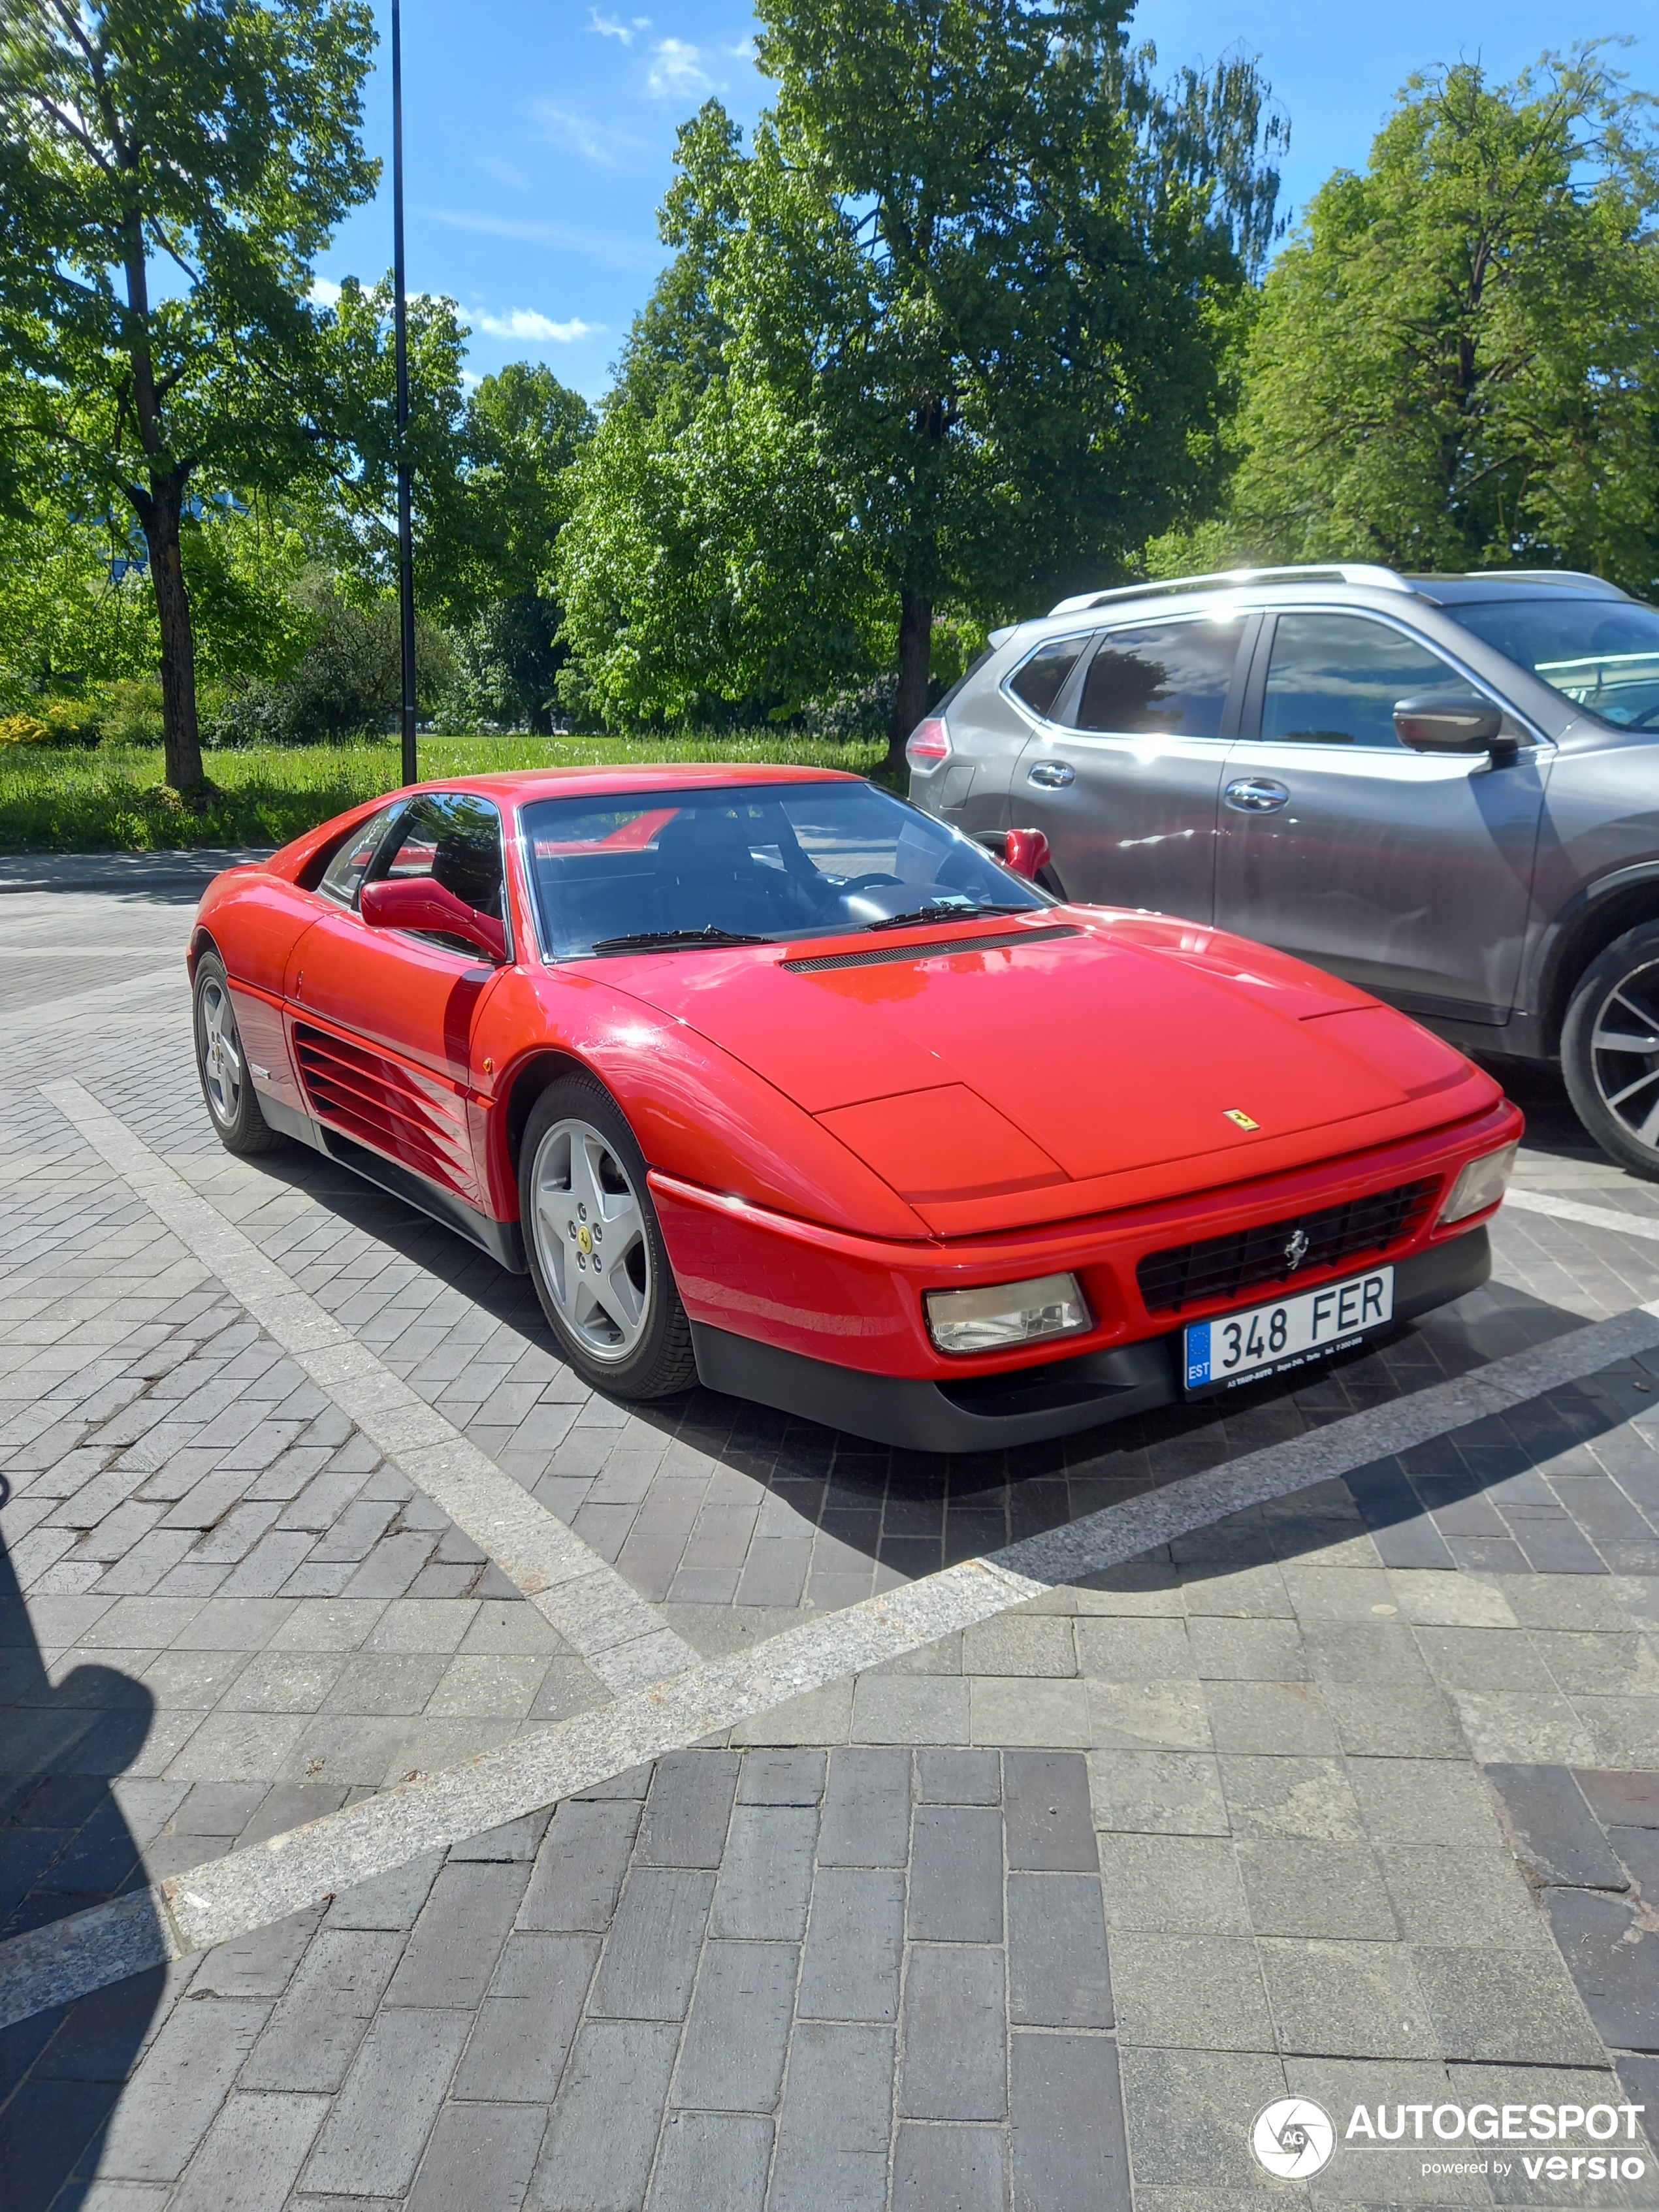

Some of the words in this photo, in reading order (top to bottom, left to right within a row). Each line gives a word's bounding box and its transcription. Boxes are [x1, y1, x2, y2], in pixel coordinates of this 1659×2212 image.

[1222, 1308, 1287, 1368] 348
[1312, 1276, 1383, 1340] FER
[1189, 1362, 1210, 1380] EST
